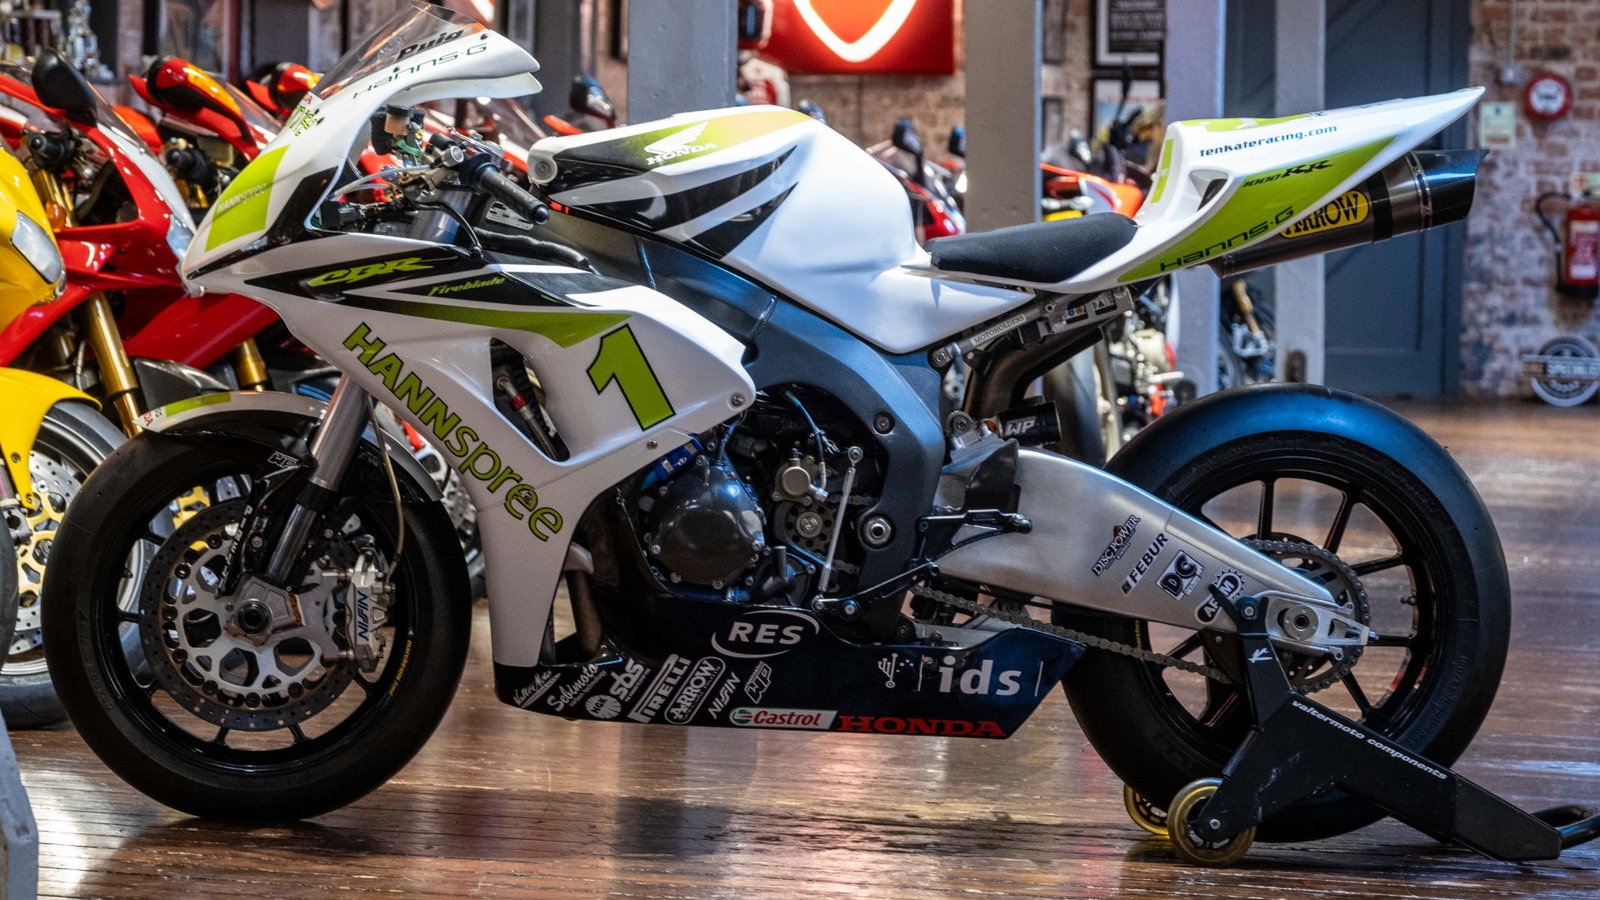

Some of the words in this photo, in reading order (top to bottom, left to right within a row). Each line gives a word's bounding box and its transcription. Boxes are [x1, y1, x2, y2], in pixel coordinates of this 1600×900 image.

[396, 28, 465, 60] Puig
[645, 142, 720, 166] HONDA
[1199, 125, 1338, 158] tenkateracing.com
[306, 256, 435, 288] CBR
[427, 276, 506, 298] Fireblade
[972, 313, 1027, 344] MOTOHOLDERS
[585, 323, 677, 432] 1
[1004, 419, 1036, 436] WP
[1129, 533, 1169, 585] FEBUR
[1160, 553, 1199, 598] DC
[1203, 579, 1236, 620] AFM
[728, 621, 804, 645] RES
[546, 663, 599, 712] Sebimoto
[609, 658, 645, 701] sbs
[627, 653, 692, 724] PIRELLI
[669, 660, 717, 721] ARROW
[938, 655, 1023, 697] ids
[752, 710, 822, 726] Castrol
[838, 715, 1007, 737] HONDA
[1291, 700, 1366, 740] valtermoto
[1366, 738, 1449, 780] components
